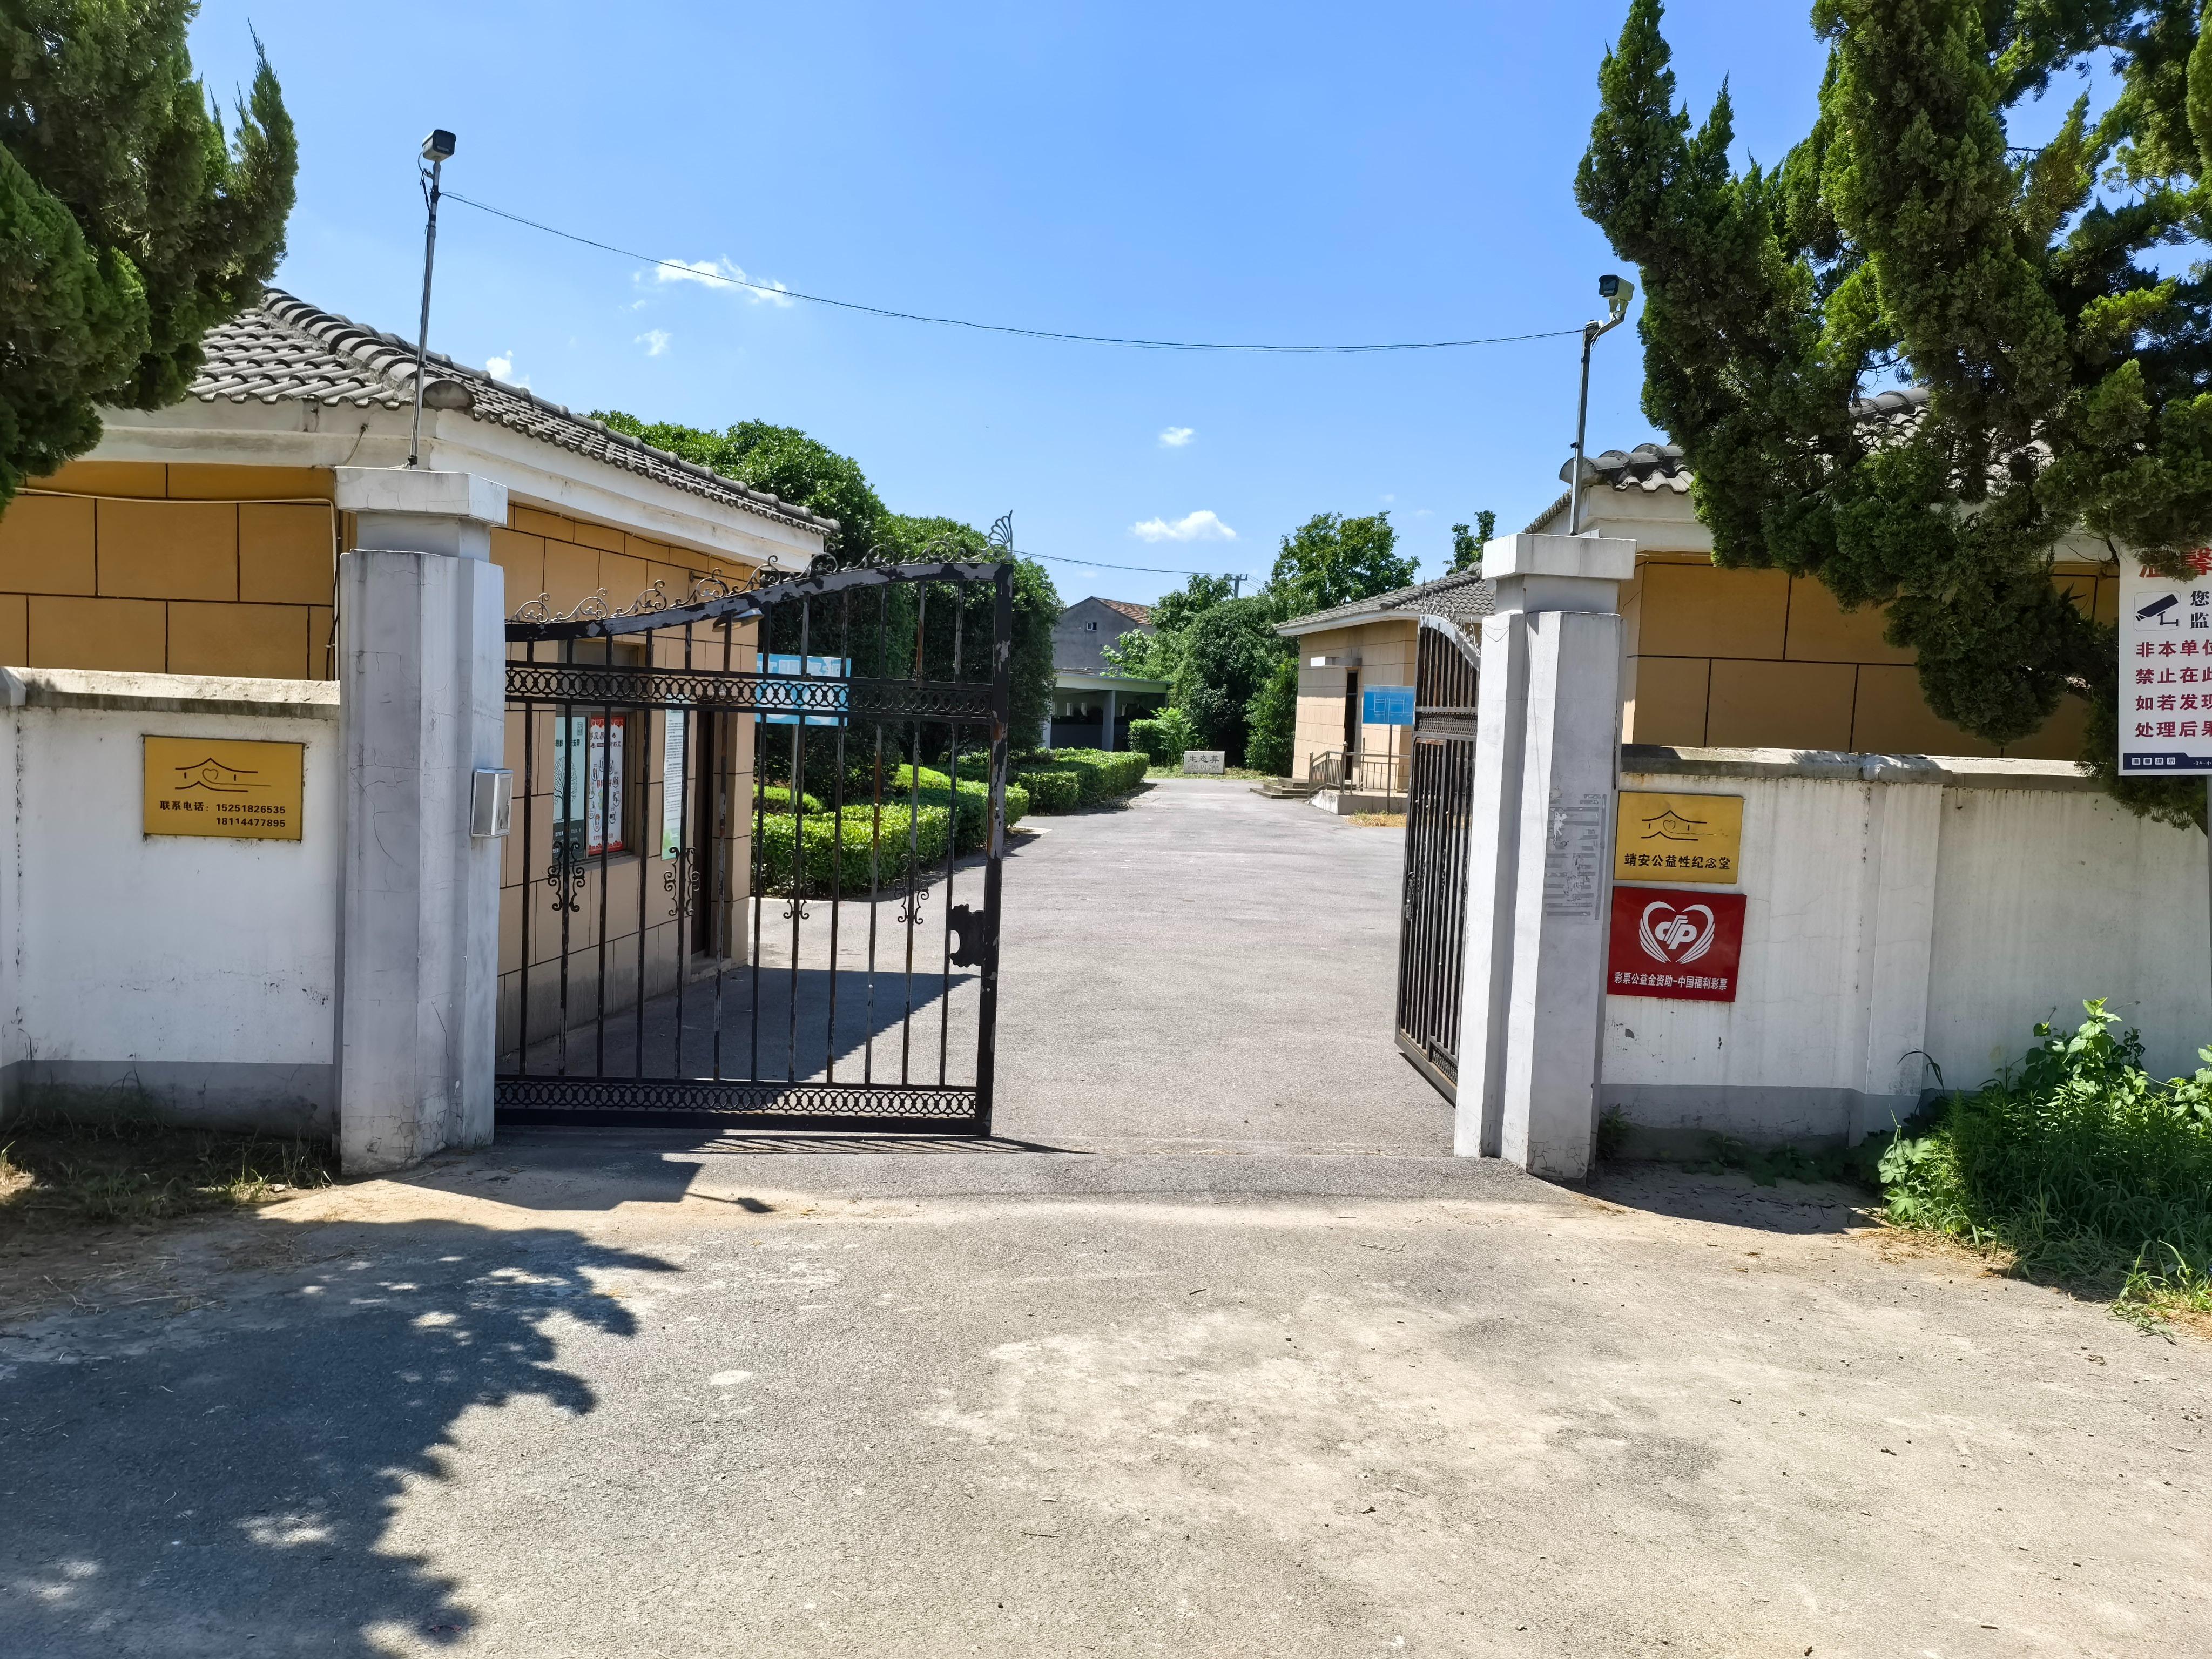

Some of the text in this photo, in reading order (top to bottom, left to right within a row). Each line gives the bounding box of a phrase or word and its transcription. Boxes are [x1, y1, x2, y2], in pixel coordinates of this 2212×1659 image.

[2190, 590, 2210, 606] 您
[2189, 612, 2209, 629] 监
[1188, 754, 1219, 764] 生态葬
[216, 803, 286, 814] 15251826535
[216, 817, 286, 827] 18114477895
[1624, 853, 1730, 869] 靖安公益性纪念堂
[1614, 972, 1728, 990] 彩票公益金资助-中国福利彩票
